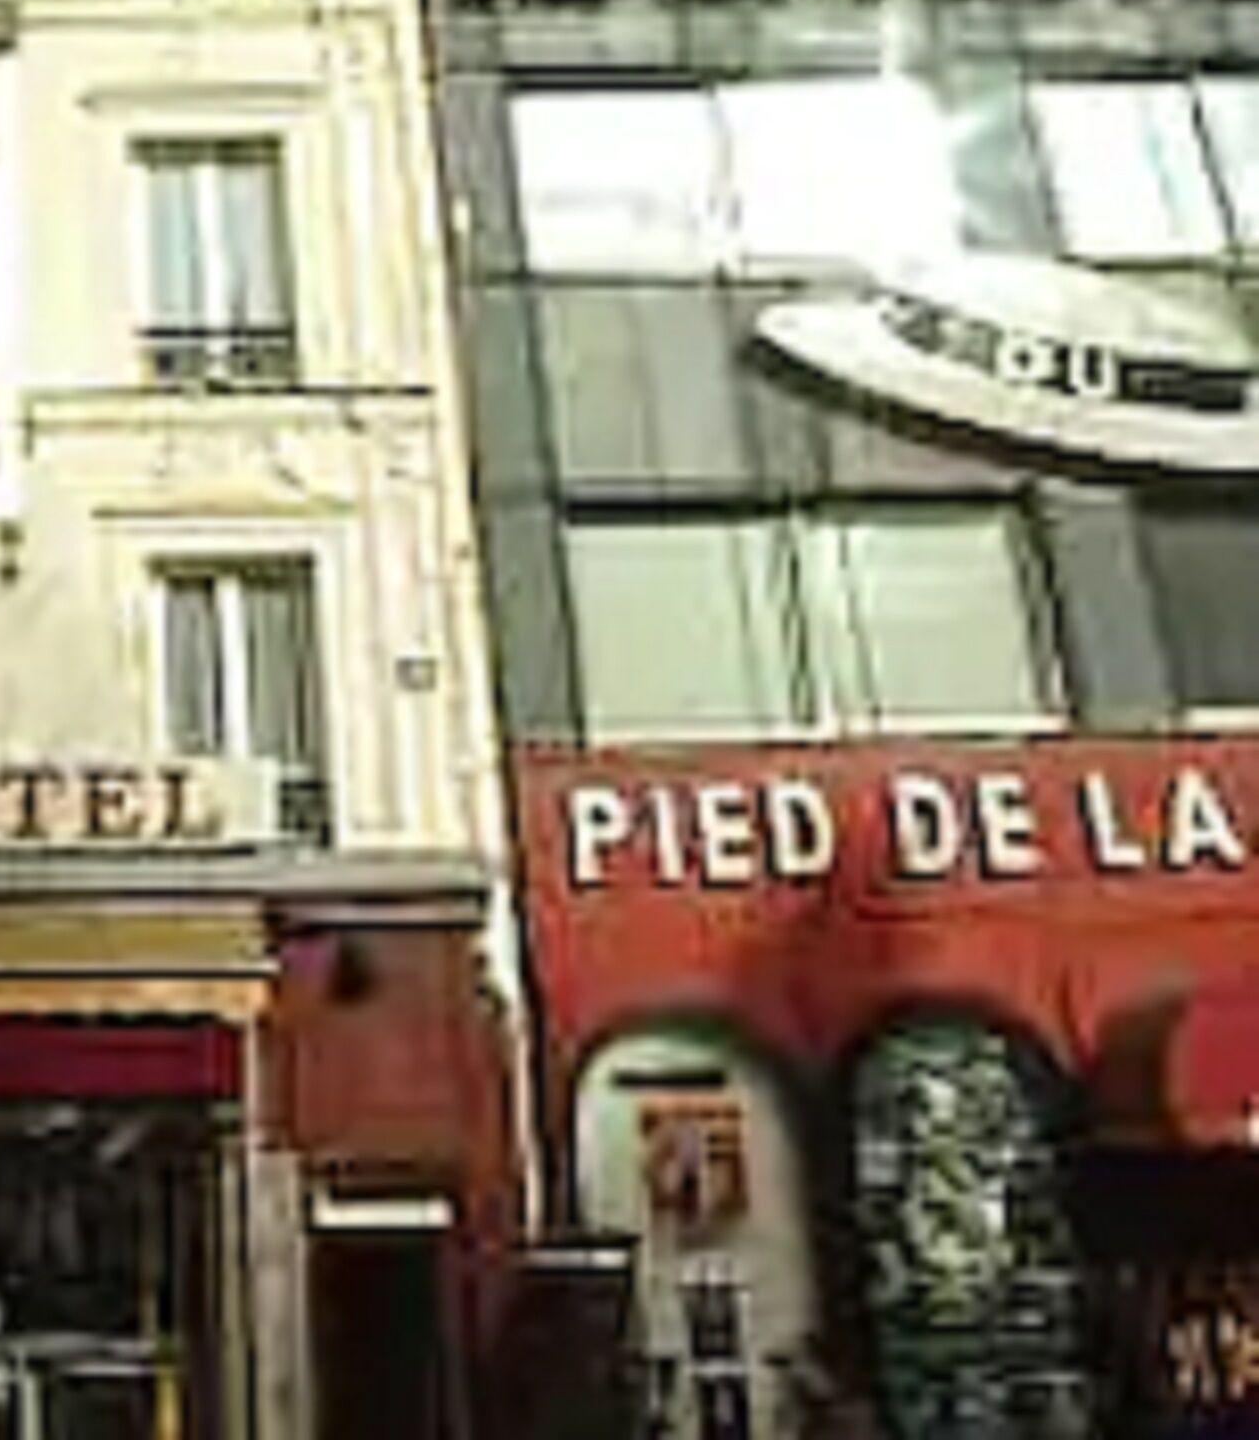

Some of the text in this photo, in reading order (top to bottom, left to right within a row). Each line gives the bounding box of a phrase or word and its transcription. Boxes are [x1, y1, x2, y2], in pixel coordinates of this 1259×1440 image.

[568, 763, 1246, 888] PIED DE LA
